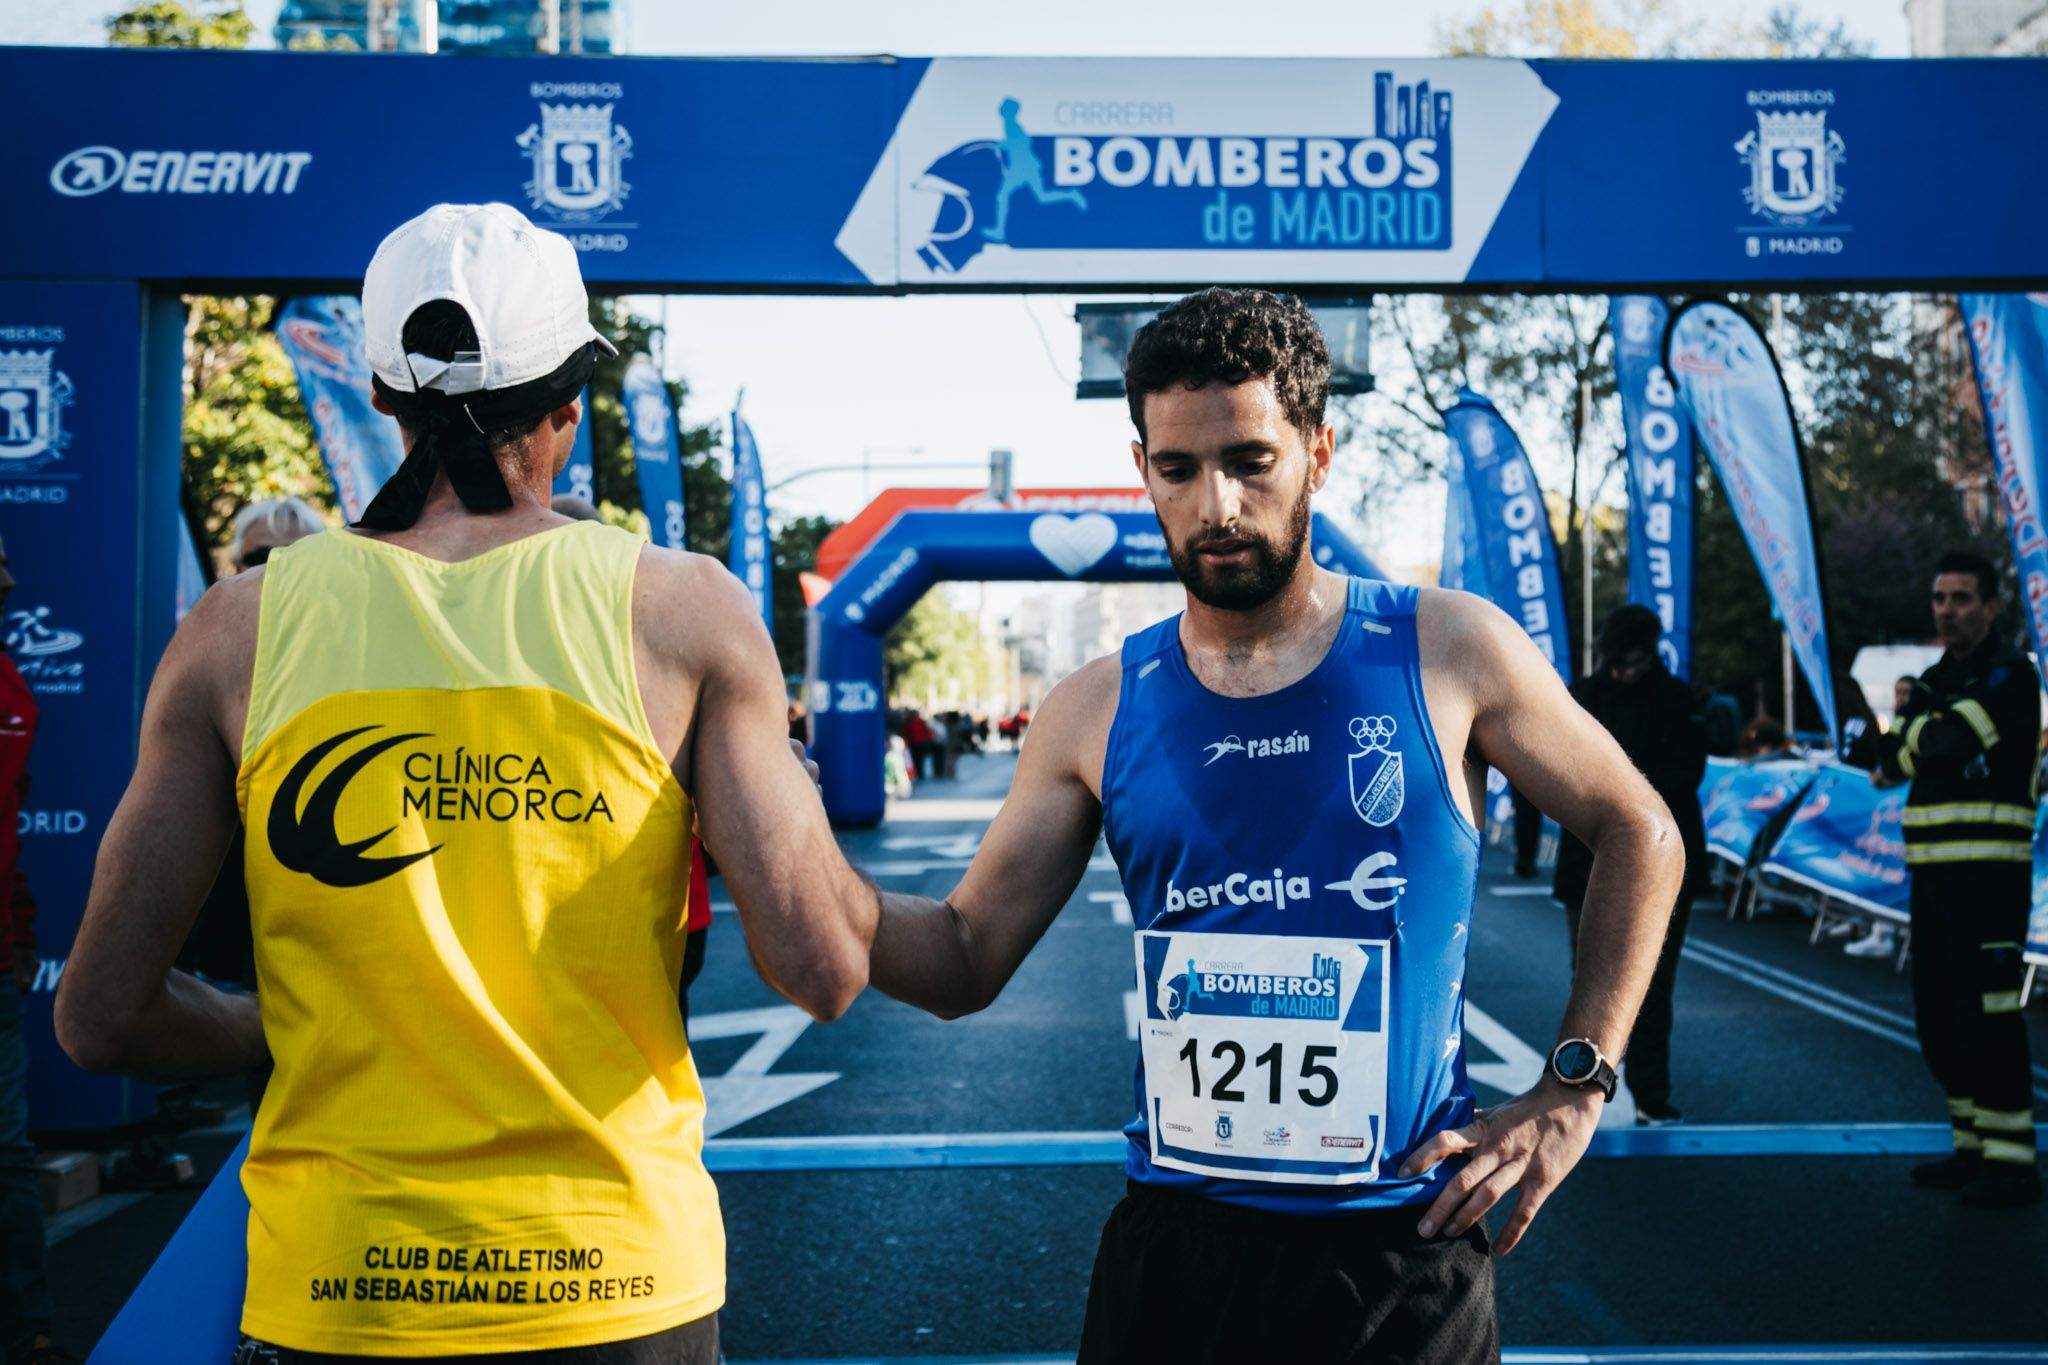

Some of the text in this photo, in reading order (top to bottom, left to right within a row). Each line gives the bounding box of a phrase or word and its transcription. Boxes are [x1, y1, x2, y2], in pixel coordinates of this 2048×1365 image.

[530, 82, 623, 98] BOMBEROS
[1747, 90, 1835, 105] BOMBEROS
[1054, 101, 1174, 127] CARRERA
[121, 151, 312, 194] ENERVIT
[1054, 137, 1440, 188] BOMBEROS
[1203, 191, 1441, 244] de MADRID
[566, 234, 629, 252] ADRID
[1768, 237, 1843, 254] MADRID
[0, 487, 67, 503] ADRID
[1247, 730, 1310, 758] rasán
[404, 747, 551, 784] CLÍNICA
[403, 786, 615, 822] MENORCA
[18, 811, 87, 834] DRID
[1165, 868, 1311, 913] berCaja
[1203, 973, 1336, 997] BOMBEROS
[1251, 995, 1336, 1017] de MADRID
[1179, 1038, 1339, 1107] 1215
[365, 1246, 603, 1272] CLUB DE ATLETISMO
[311, 1274, 655, 1304] SAN SEBASTIÁN DE LOS REYES
